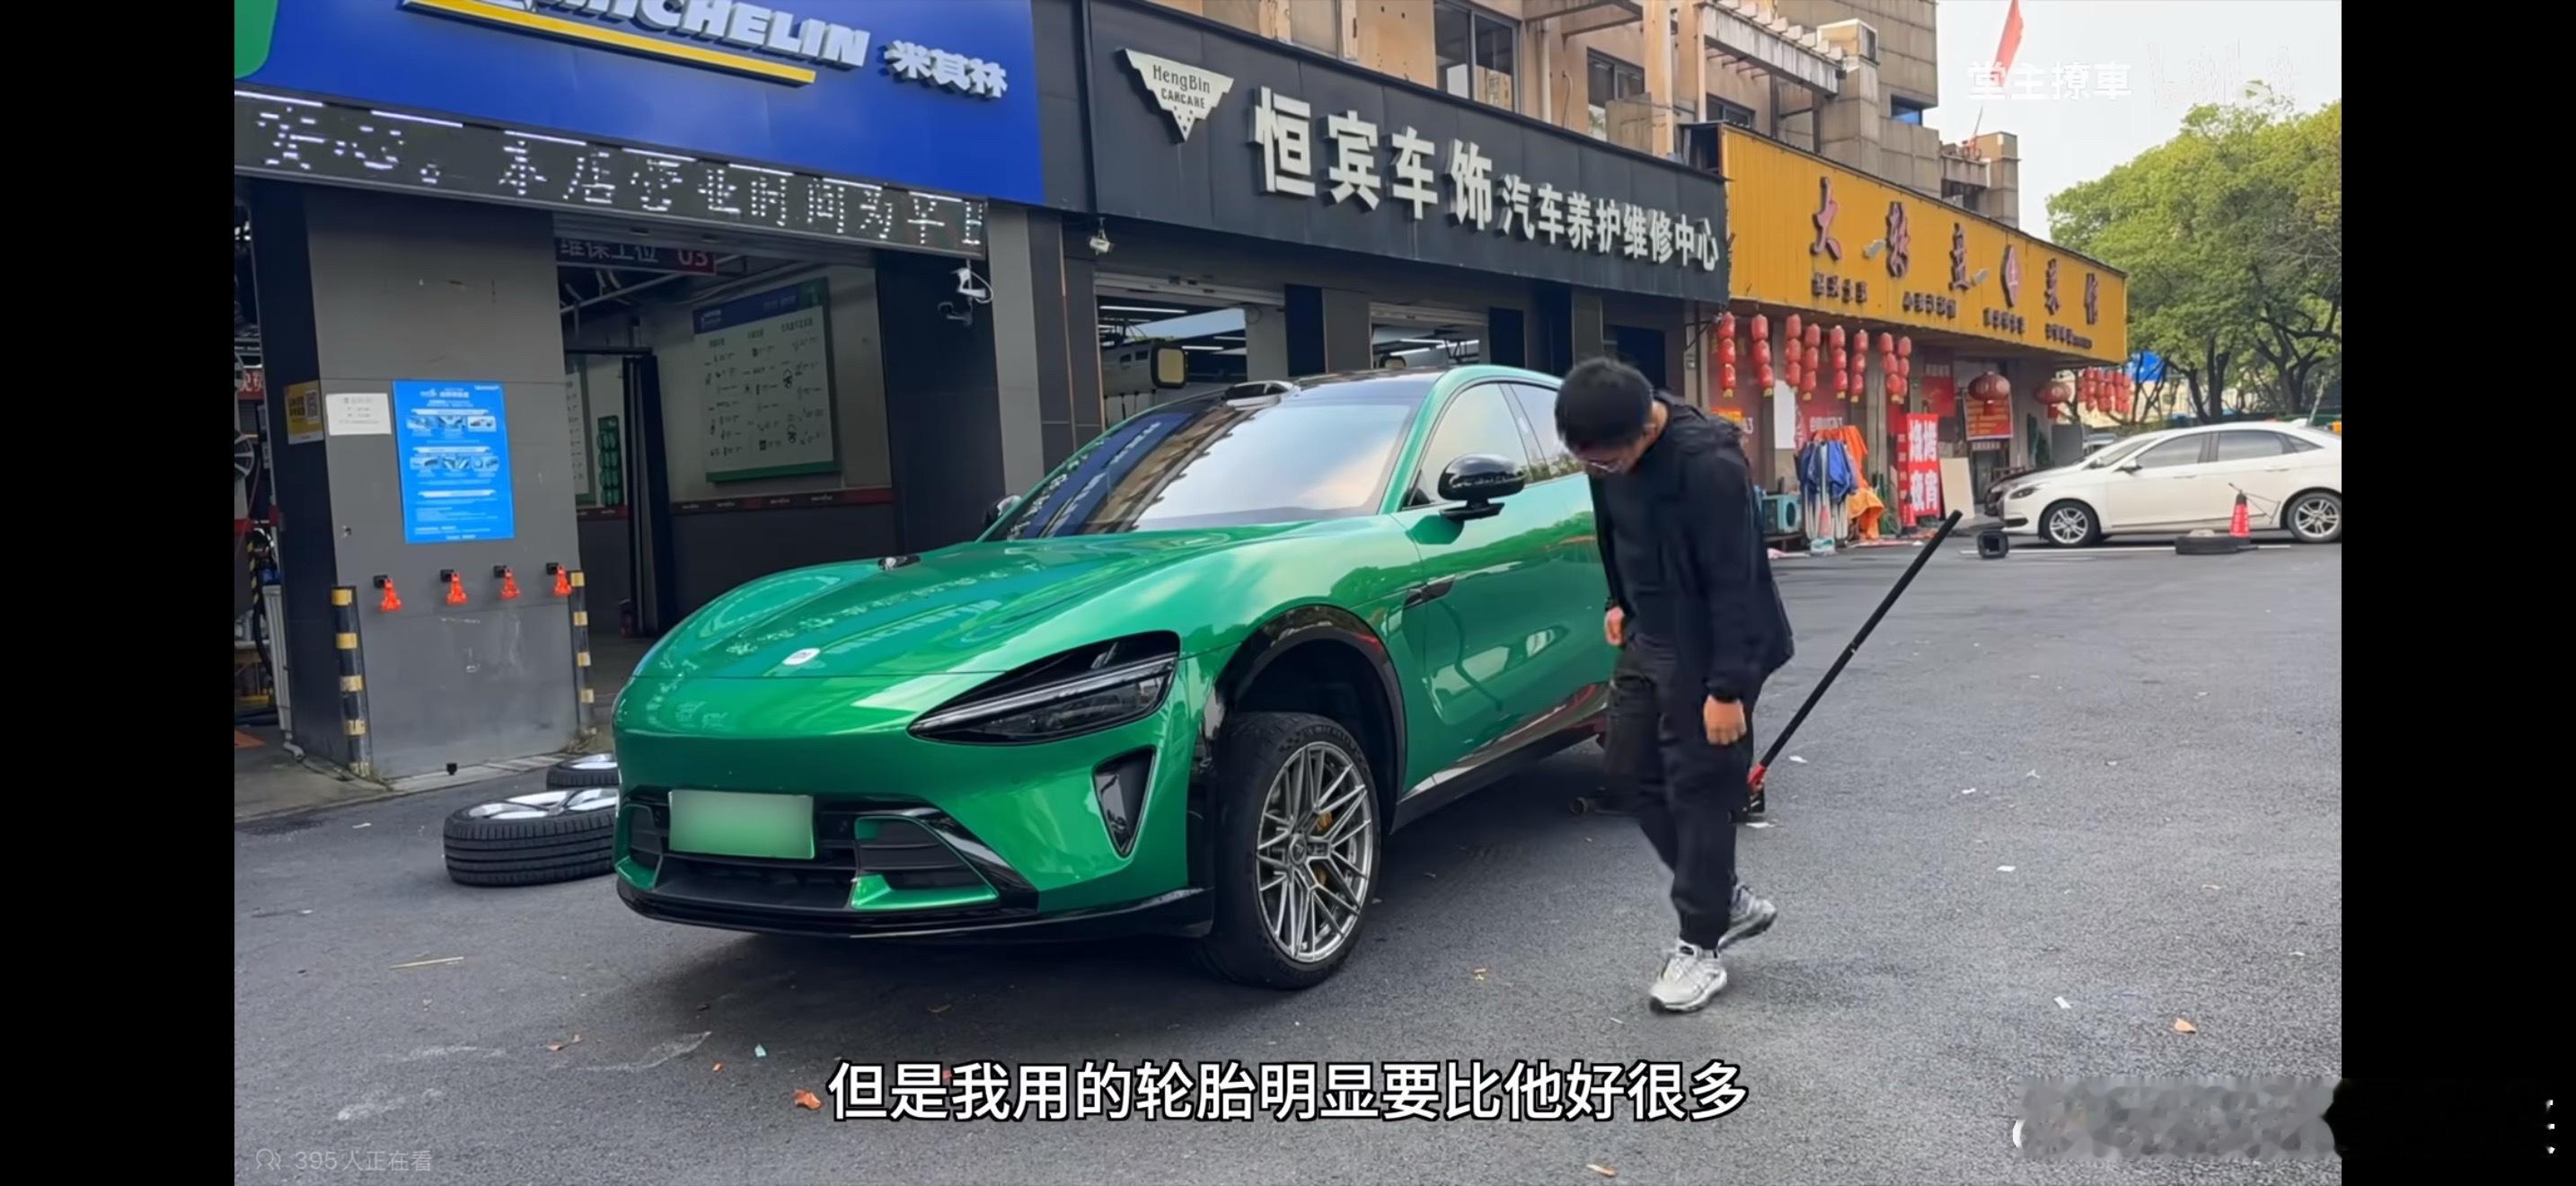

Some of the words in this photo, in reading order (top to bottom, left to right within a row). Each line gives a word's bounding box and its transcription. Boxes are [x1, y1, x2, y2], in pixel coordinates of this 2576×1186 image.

[559, 0, 870, 67] CHELIN
[886, 40, 1008, 98] 米其林
[1152, 64, 1211, 94] HengBin
[1160, 87, 1206, 109] CARCARE
[1254, 85, 1494, 232] 恒宾车饰
[1499, 173, 1720, 271] 汽车养护维修中心
